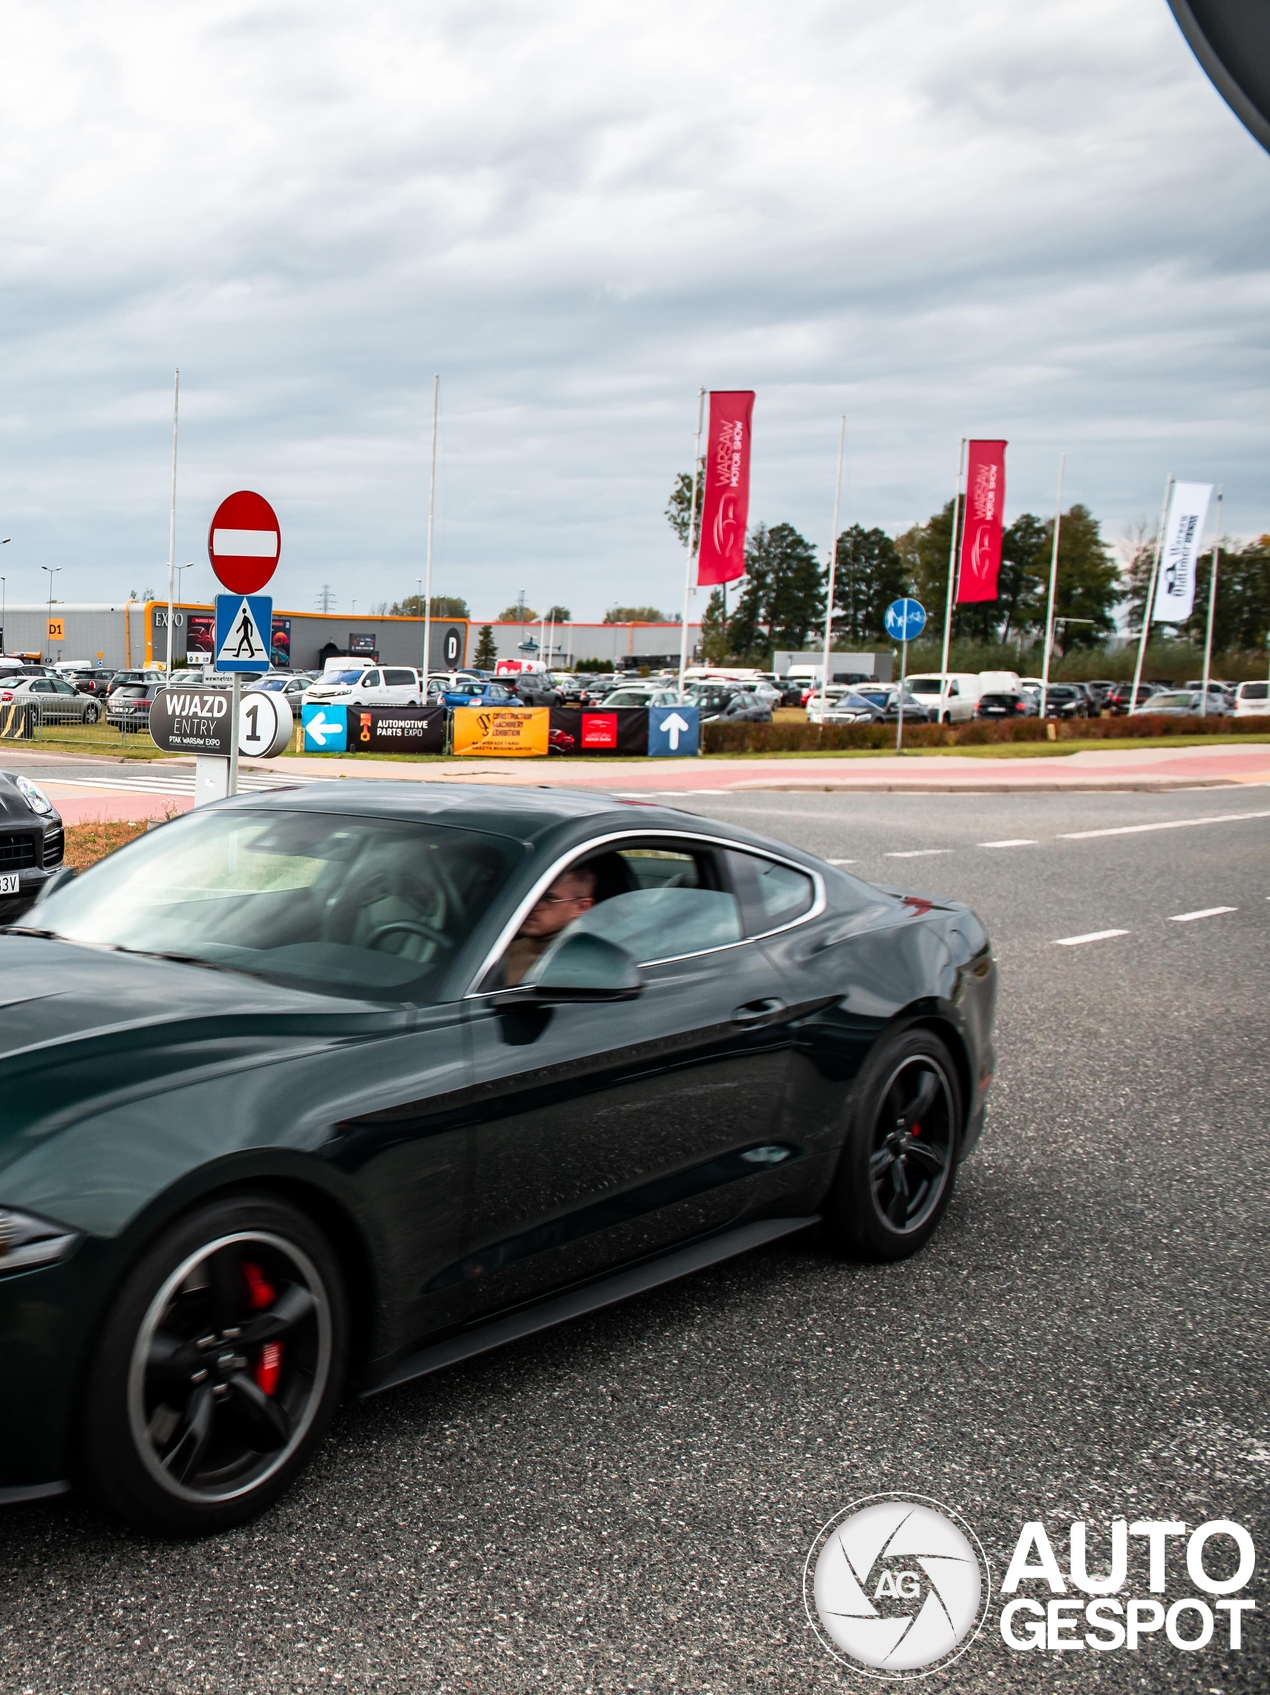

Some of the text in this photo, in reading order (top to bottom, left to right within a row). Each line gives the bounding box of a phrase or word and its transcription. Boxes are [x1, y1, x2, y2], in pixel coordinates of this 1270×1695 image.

[714, 419, 734, 487] WARSAW
[729, 420, 743, 487] MOTOR SHOW
[972, 463, 990, 520] WARSAW
[985, 463, 998, 520] MOTOR SHOW
[49, 624, 62, 635] D1
[448, 636, 458, 659] D
[165, 694, 228, 718] WJAZD
[173, 718, 217, 736] ENTRY
[245, 705, 261, 742] 1
[376, 728, 423, 737] PARTS EXPO
[377, 719, 429, 729] AUTOMOTIVE
[168, 735, 182, 743] PTAK
[182, 736, 205, 745] WARSAW
[205, 738, 221, 746] EXPO
